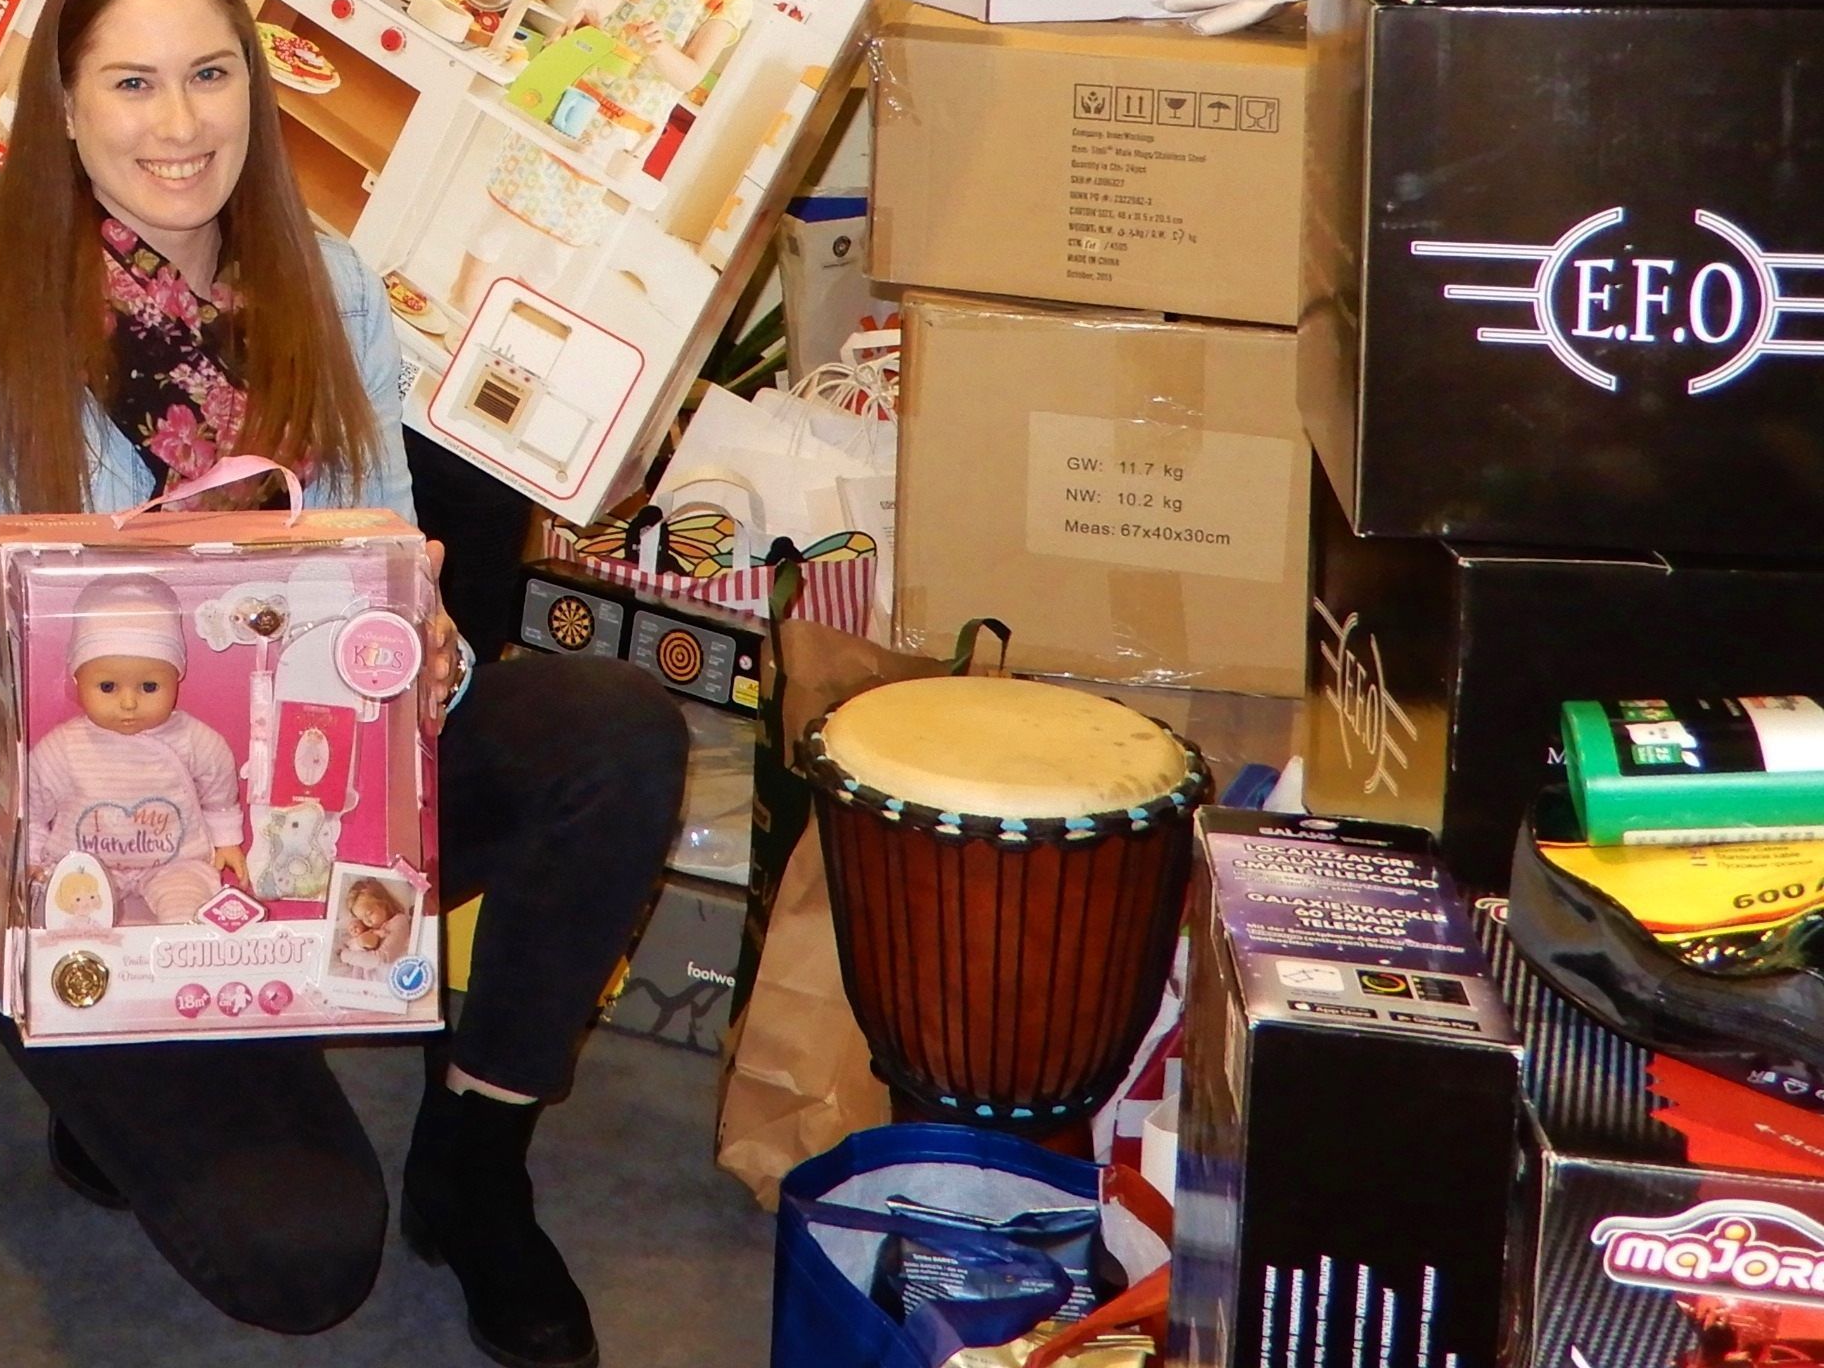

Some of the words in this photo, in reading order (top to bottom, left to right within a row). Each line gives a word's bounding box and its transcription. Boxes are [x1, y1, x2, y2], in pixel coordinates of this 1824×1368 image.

[1067, 254, 1087, 264] MADE
[1097, 257, 1120, 267] CHINA
[1571, 258, 1744, 344] E.F.O
[1066, 456, 1104, 473] GW:
[1119, 461, 1155, 477] 11.7
[1163, 463, 1185, 481] kg
[1065, 488, 1102, 504] NW:
[1118, 492, 1154, 508] 10.2
[1163, 495, 1184, 513] kg
[1064, 519, 1116, 537] Meas:
[1120, 523, 1231, 545] 67x40x30cm
[1245, 843, 1415, 869] LOCALIZZATORE
[1256, 854, 1374, 874] GALATTICO
[1380, 867, 1409, 877] 60
[1233, 860, 1308, 874] SMART
[1313, 867, 1439, 889] TELESCOPIO
[1733, 882, 1805, 909] 600
[1294, 908, 1325, 918] 60
[1330, 911, 1405, 928] SMART
[1298, 917, 1407, 936] TELESKOP
[157, 933, 306, 969] SCHILDKRÖT
[687, 961, 736, 987] footwe
[1315, 1006, 1339, 1015] App
[1340, 1009, 1371, 1018] Store
[1413, 1016, 1451, 1028] Google
[1451, 1021, 1475, 1031] Play
[1265, 1265, 1277, 1293] AVISO!
[1318, 1254, 1332, 1295] ACHTUNG!
[1355, 1263, 1369, 1317] AVVERTENZA!
[1421, 1265, 1436, 1312] ATTENTION!
